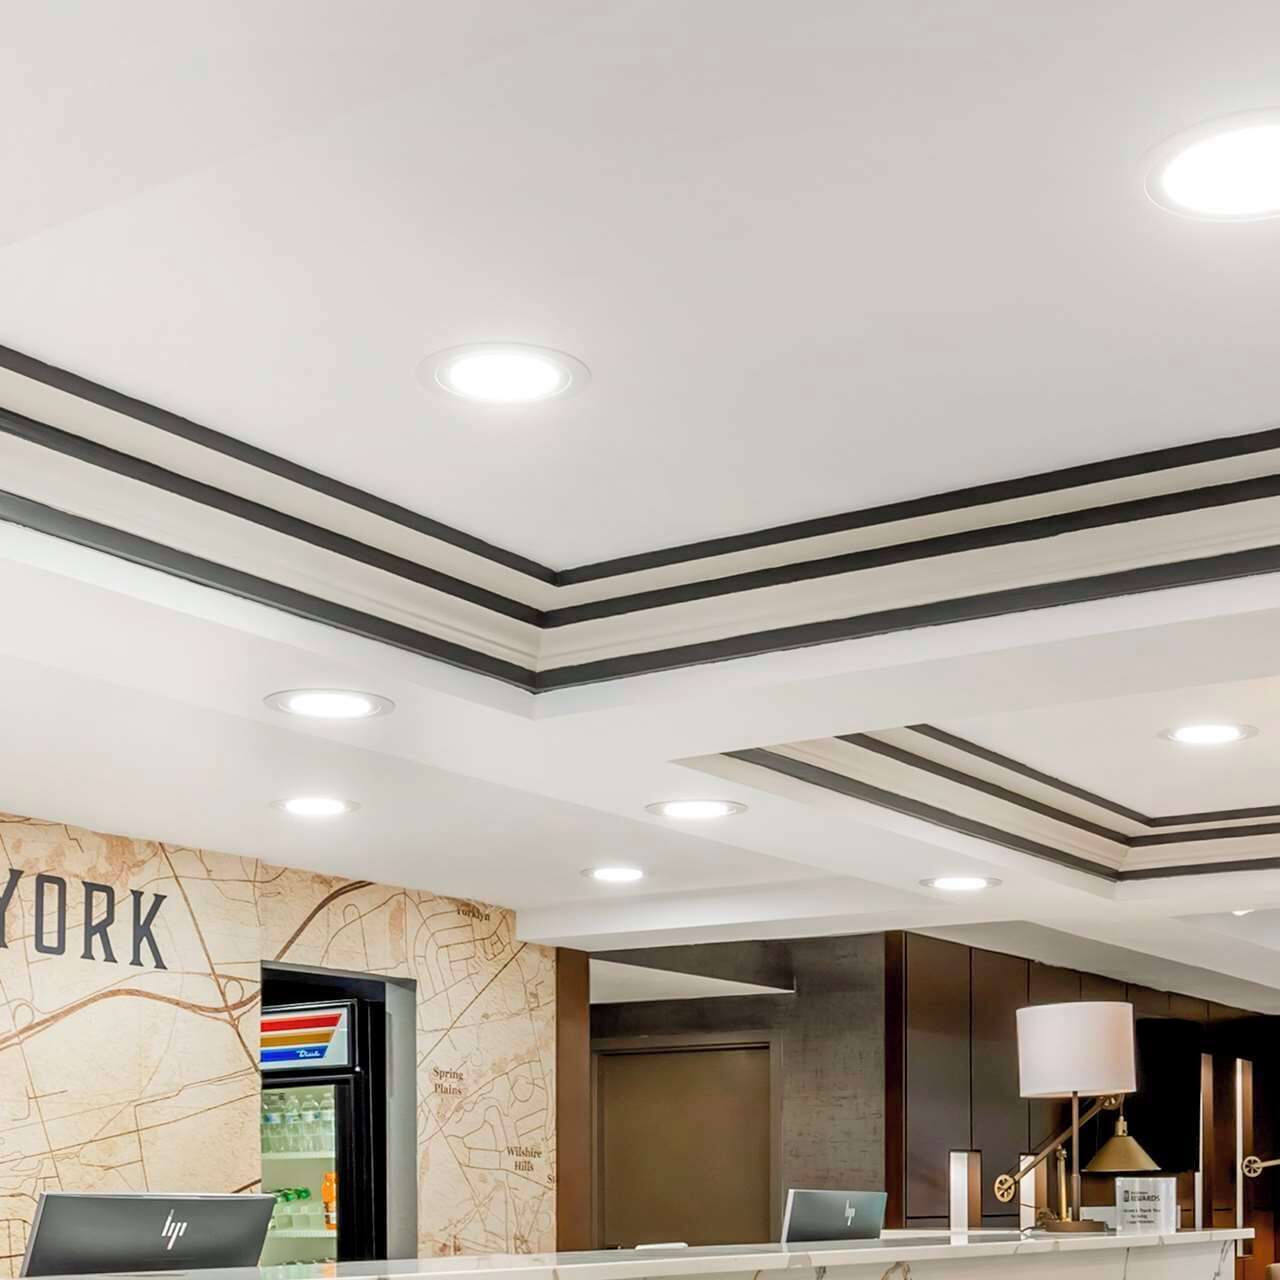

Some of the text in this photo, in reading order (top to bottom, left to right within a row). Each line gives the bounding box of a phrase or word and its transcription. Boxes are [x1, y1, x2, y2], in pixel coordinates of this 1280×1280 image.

[432, 1067, 464, 1081] Spring
[434, 1083, 462, 1095] Plains
[506, 1146, 542, 1159] Wilshire
[514, 1160, 534, 1171] Hills
[161, 1209, 188, 1250] hp
